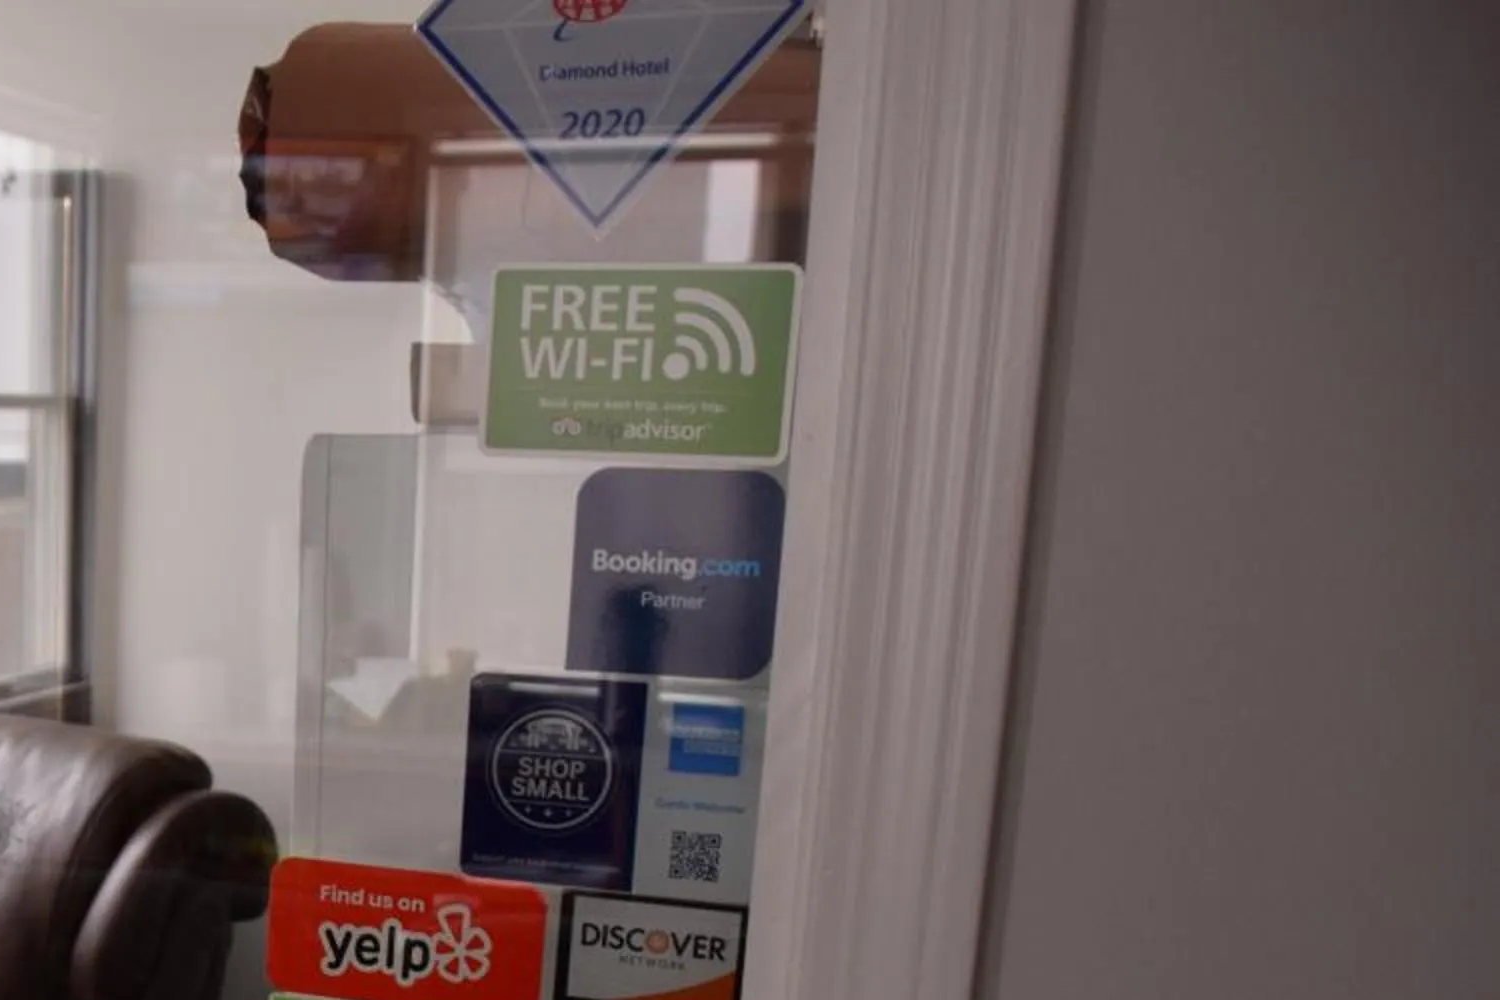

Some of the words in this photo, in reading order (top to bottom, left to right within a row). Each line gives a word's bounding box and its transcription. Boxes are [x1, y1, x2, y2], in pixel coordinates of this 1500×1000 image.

[623, 57, 670, 77] Hotel
[559, 107, 646, 140] 2020
[520, 284, 658, 332] FREE
[520, 336, 655, 382] WI-FI
[592, 548, 761, 581] Booking.com
[641, 590, 706, 610] Partner
[518, 755, 586, 780] SHOP
[511, 775, 590, 802] SMALL
[319, 883, 366, 907] Find
[368, 893, 393, 910] us
[397, 895, 426, 913] on
[320, 917, 436, 986] yelp
[580, 920, 727, 963] DISCOVER
